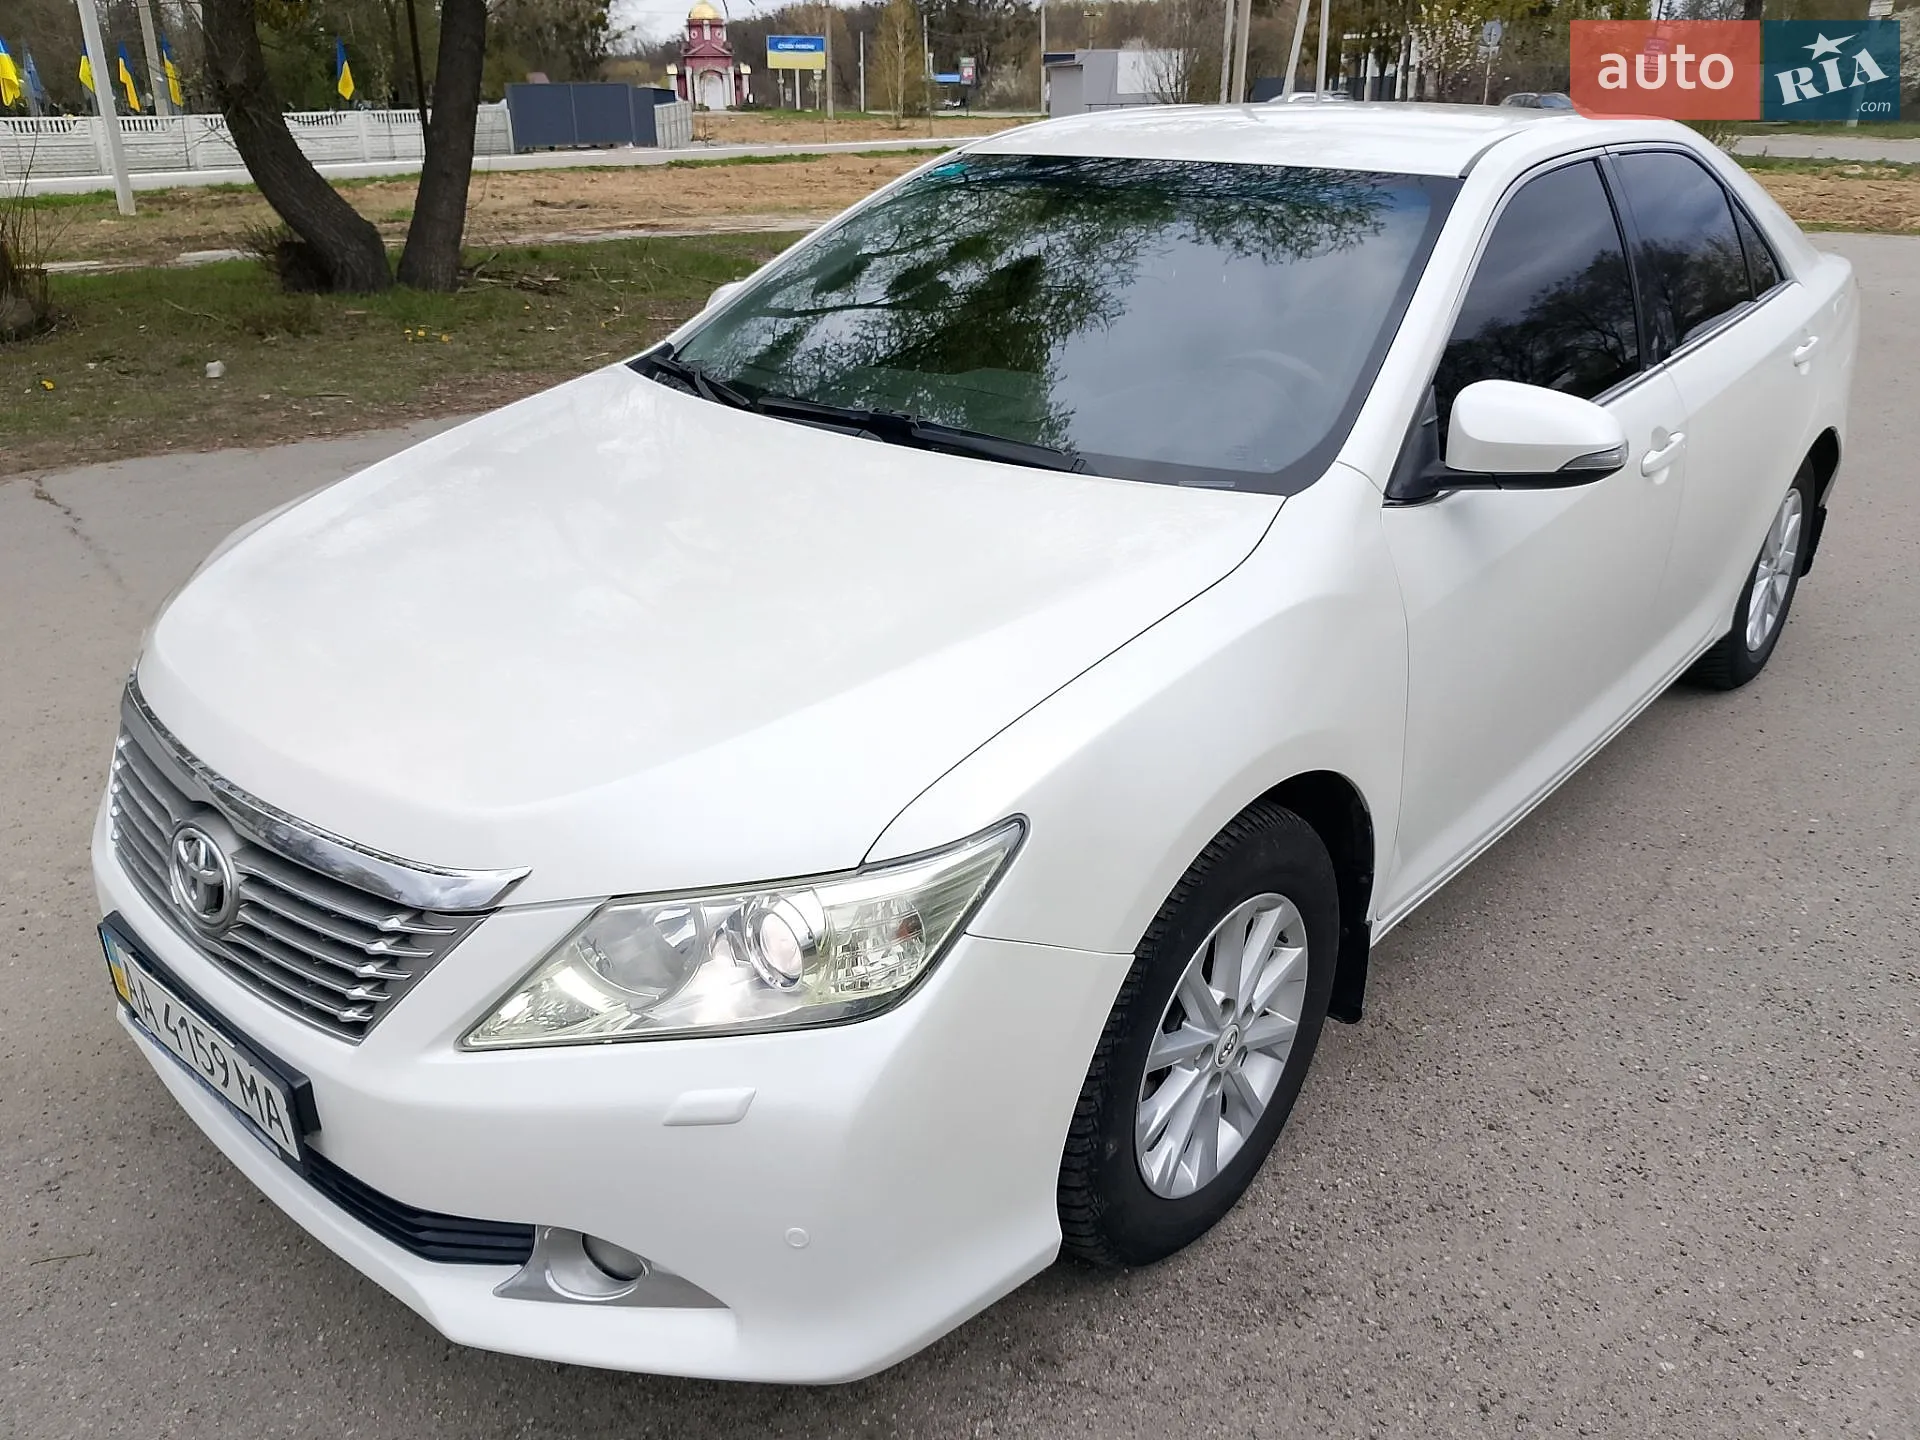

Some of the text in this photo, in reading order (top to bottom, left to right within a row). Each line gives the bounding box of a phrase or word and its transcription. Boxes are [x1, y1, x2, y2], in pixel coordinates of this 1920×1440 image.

[123, 959, 290, 1145] AA 4159 MA
